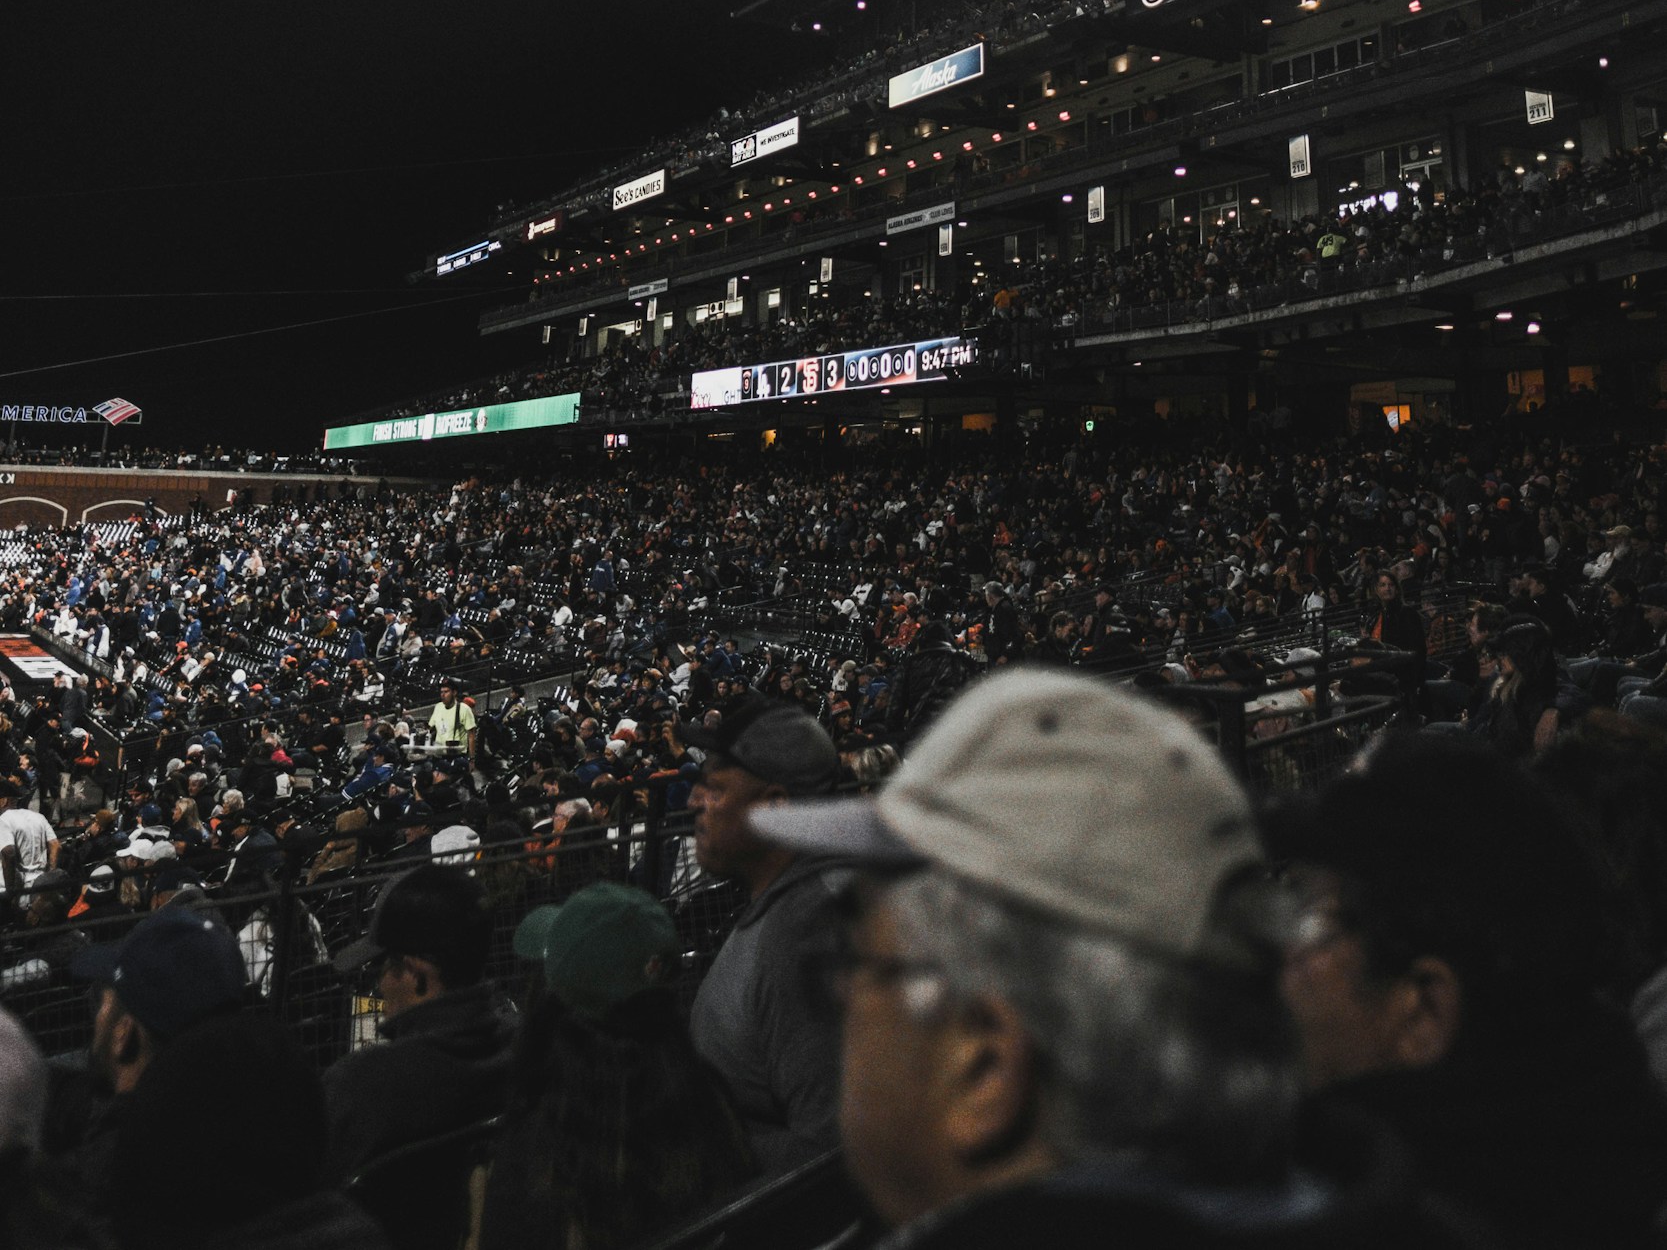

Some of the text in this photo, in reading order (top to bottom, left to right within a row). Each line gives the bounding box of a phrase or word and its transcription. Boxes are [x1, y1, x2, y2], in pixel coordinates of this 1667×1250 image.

[911, 59, 958, 95] Alaska
[1529, 107, 1547, 119] 211
[767, 127, 795, 144] INVESTIGATE
[1292, 163, 1305, 174] 210
[615, 179, 661, 206] See's CANDIES
[858, 356, 869, 381] 0
[880, 352, 891, 378] 0
[904, 349, 915, 376] 0
[921, 345, 971, 371] 9:47 PM
[780, 366, 791, 393] 2
[827, 359, 838, 387] 3
[393, 420, 418, 439] STRONG
